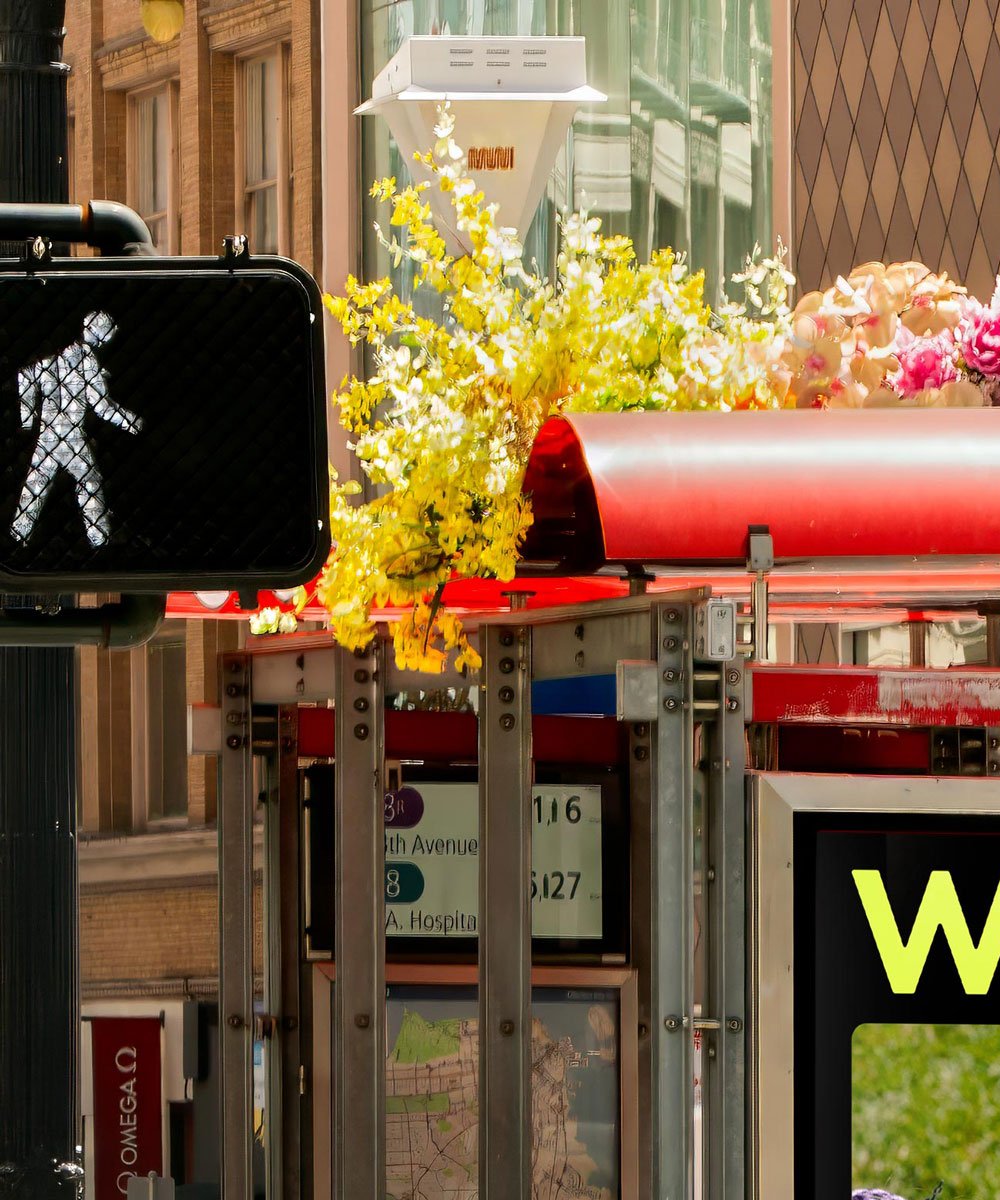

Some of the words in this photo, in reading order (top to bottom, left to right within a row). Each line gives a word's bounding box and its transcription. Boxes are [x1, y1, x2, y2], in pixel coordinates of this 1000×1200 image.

[384, 833, 406, 856] th
[411, 834, 478, 856] Avenue
[410, 909, 477, 936] Hospita
[119, 1077, 138, 1165] OMEGA
